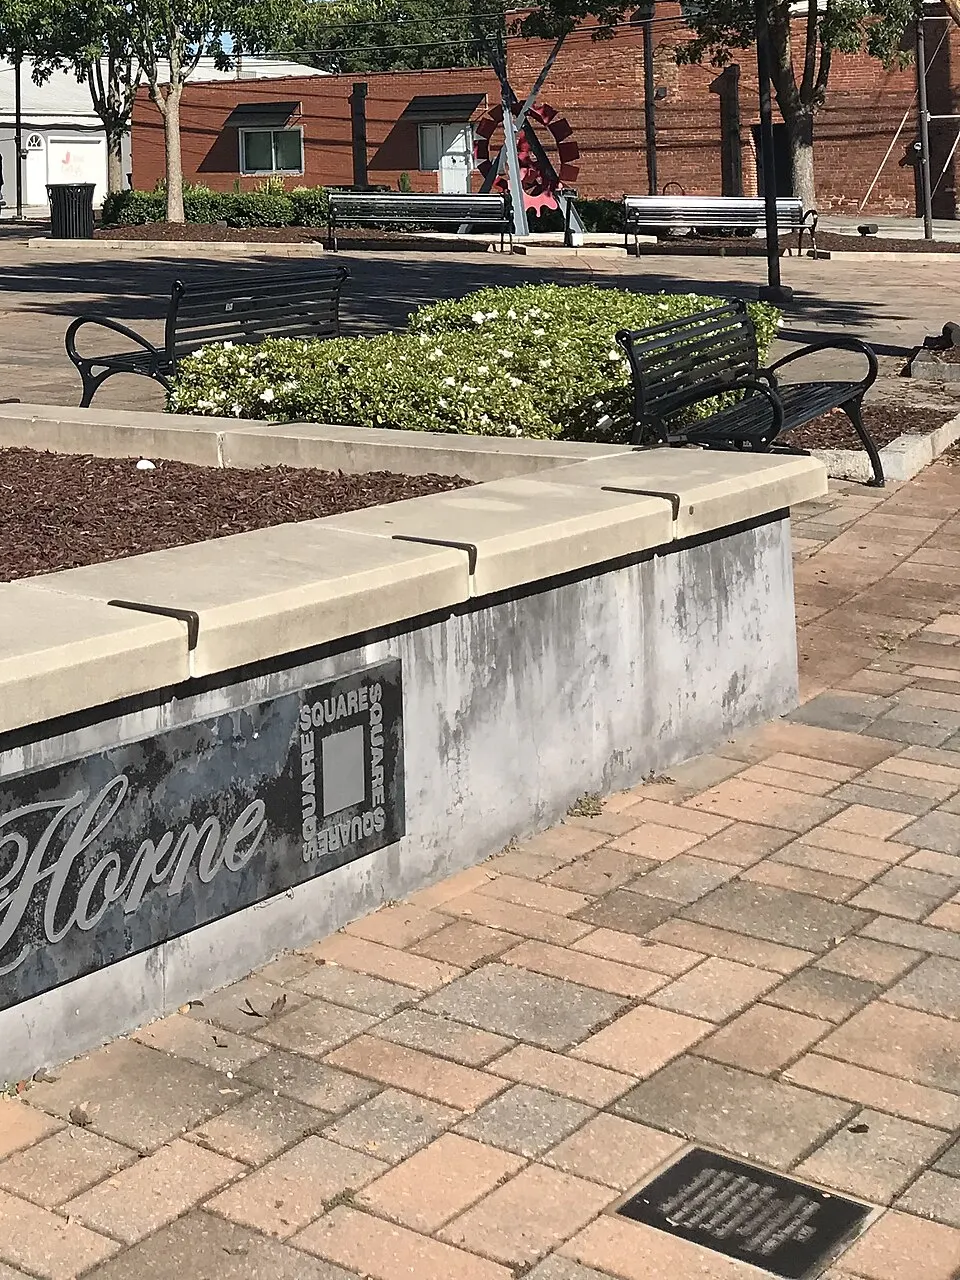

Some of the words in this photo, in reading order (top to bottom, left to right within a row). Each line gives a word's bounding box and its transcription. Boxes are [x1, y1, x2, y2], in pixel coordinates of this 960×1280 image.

[300, 686, 368, 731] SQUARE
[369, 682, 385, 808] SQUARE
[300, 730, 317, 862] SQUARE
[316, 806, 385, 858] SQUARE
